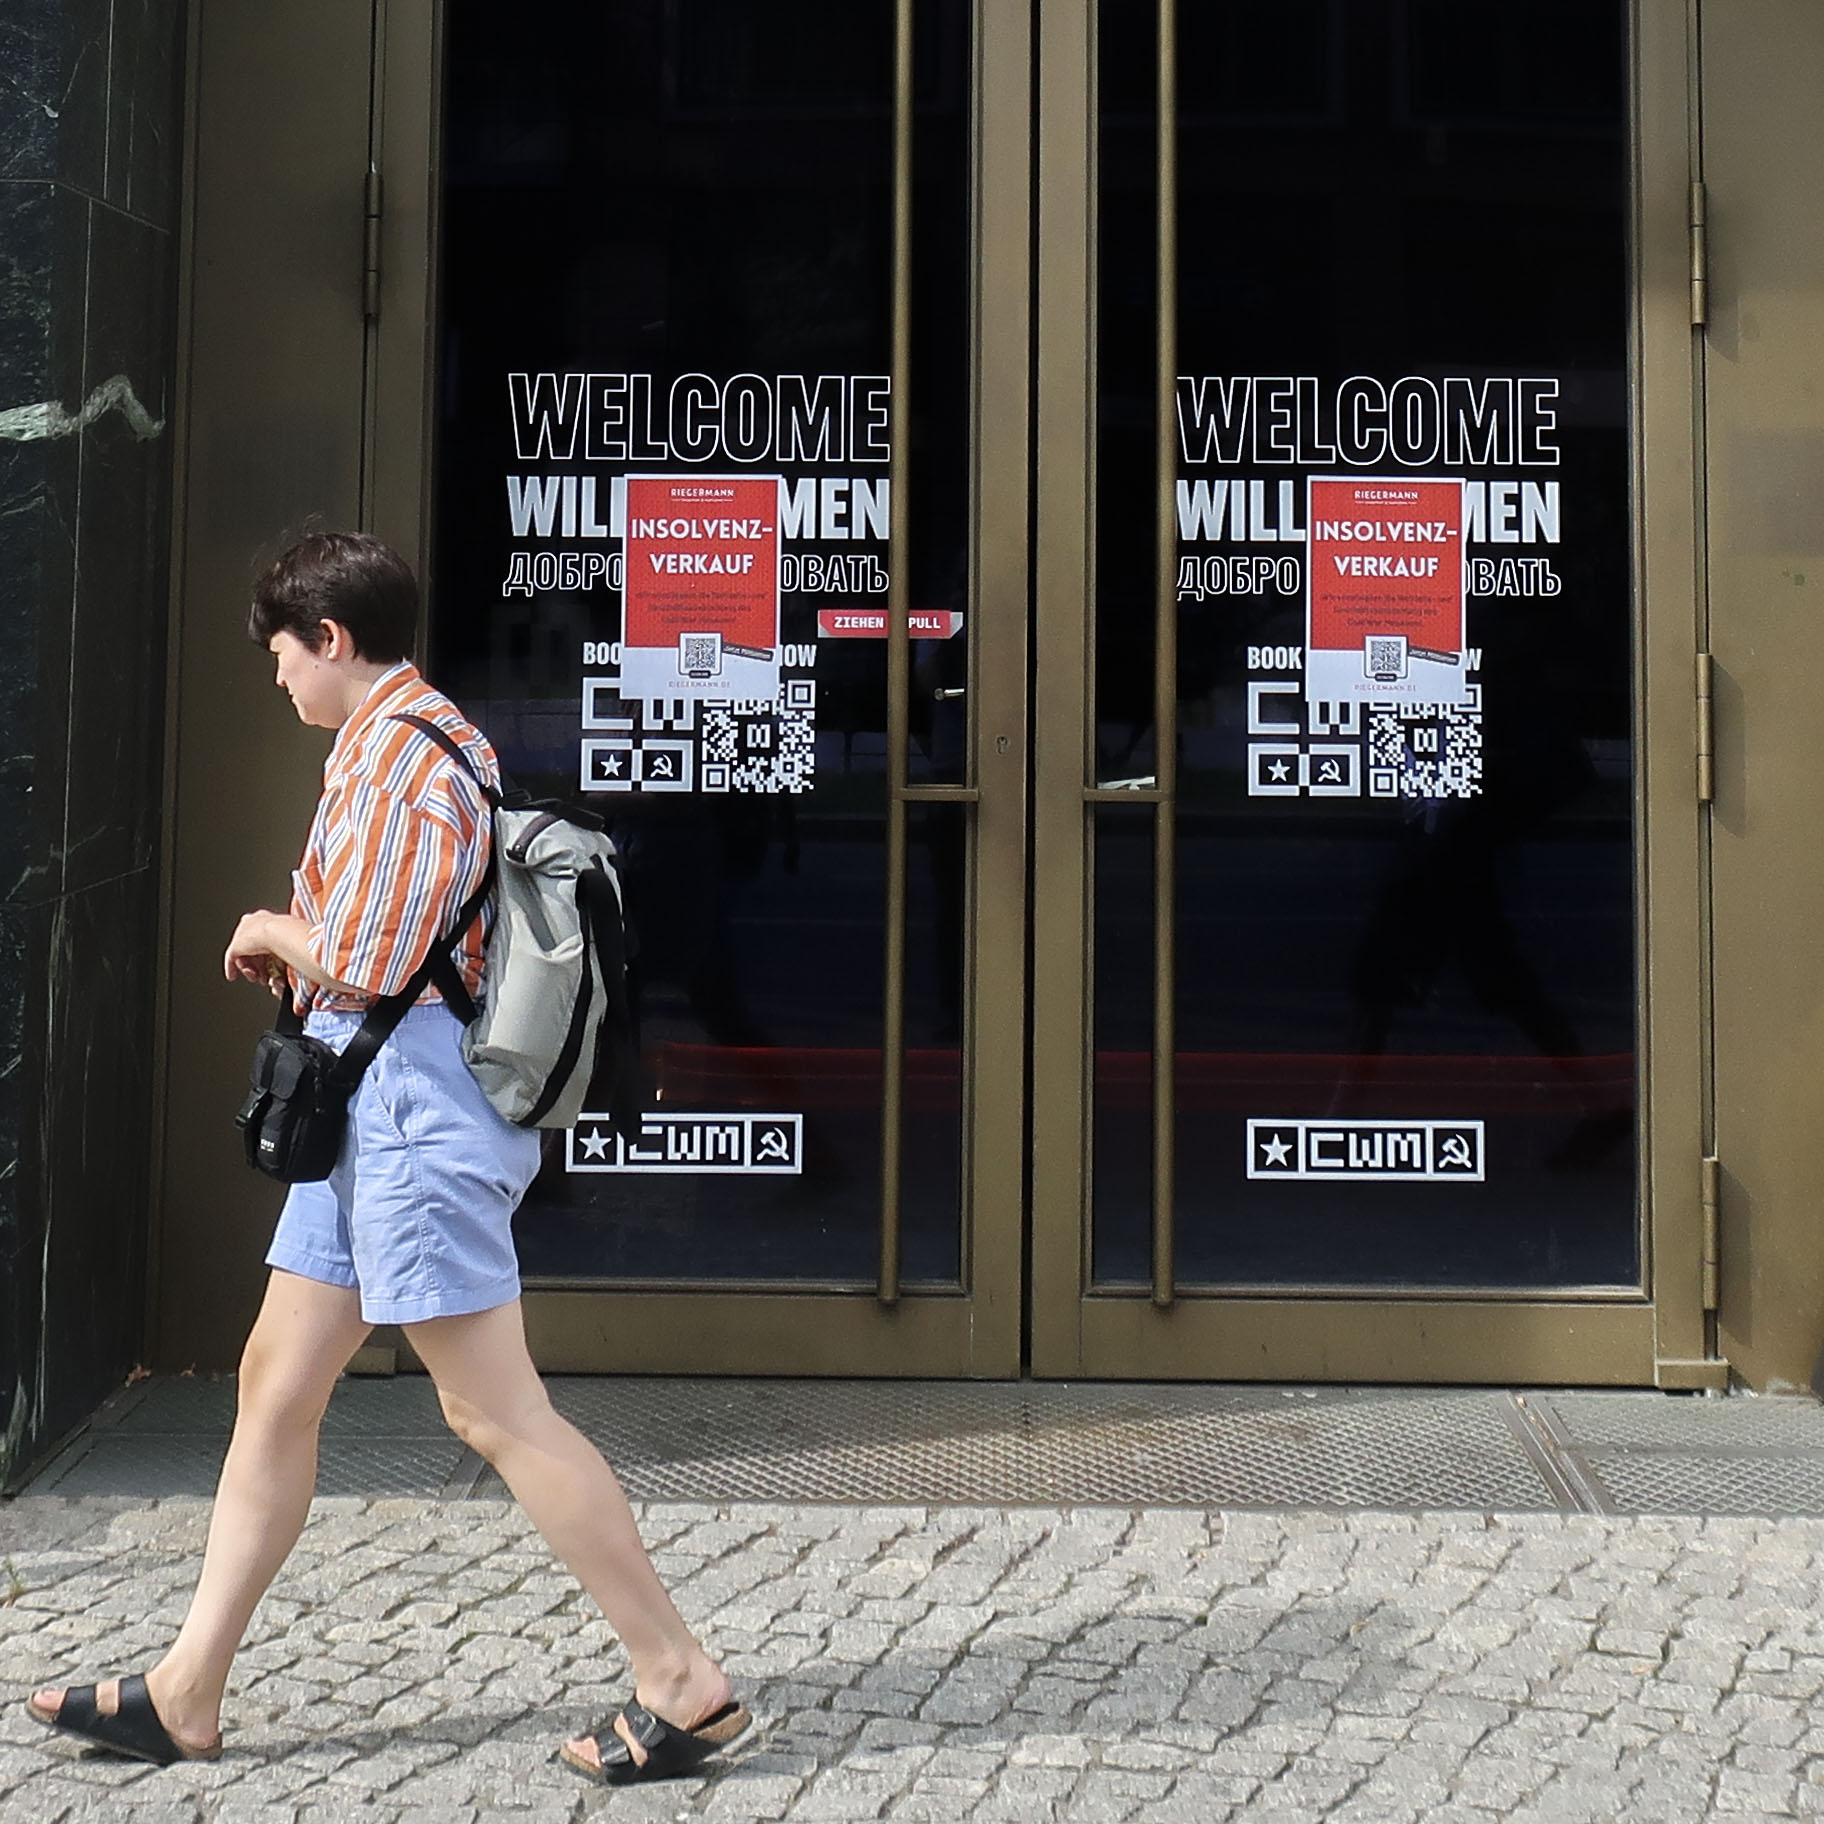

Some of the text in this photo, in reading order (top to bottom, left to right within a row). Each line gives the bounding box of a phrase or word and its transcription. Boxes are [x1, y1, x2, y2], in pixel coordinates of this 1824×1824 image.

[507, 372, 890, 463] WELCOME
[1177, 376, 1560, 466] WELCOME
[1354, 490, 1418, 501] RIEGERMANN
[631, 518, 773, 539] INSOLVENZ-
[1315, 520, 1458, 542] INSOLVENZ-
[649, 553, 754, 574] VERKAUF
[1334, 555, 1439, 577] VERKAUF
[1177, 555, 1300, 602] ДОБРО
[834, 616, 941, 629] ZIEHEN PULL
[583, 641, 623, 666] BOO
[780, 644, 817, 668] OW
[1247, 646, 1303, 670] BOOK
